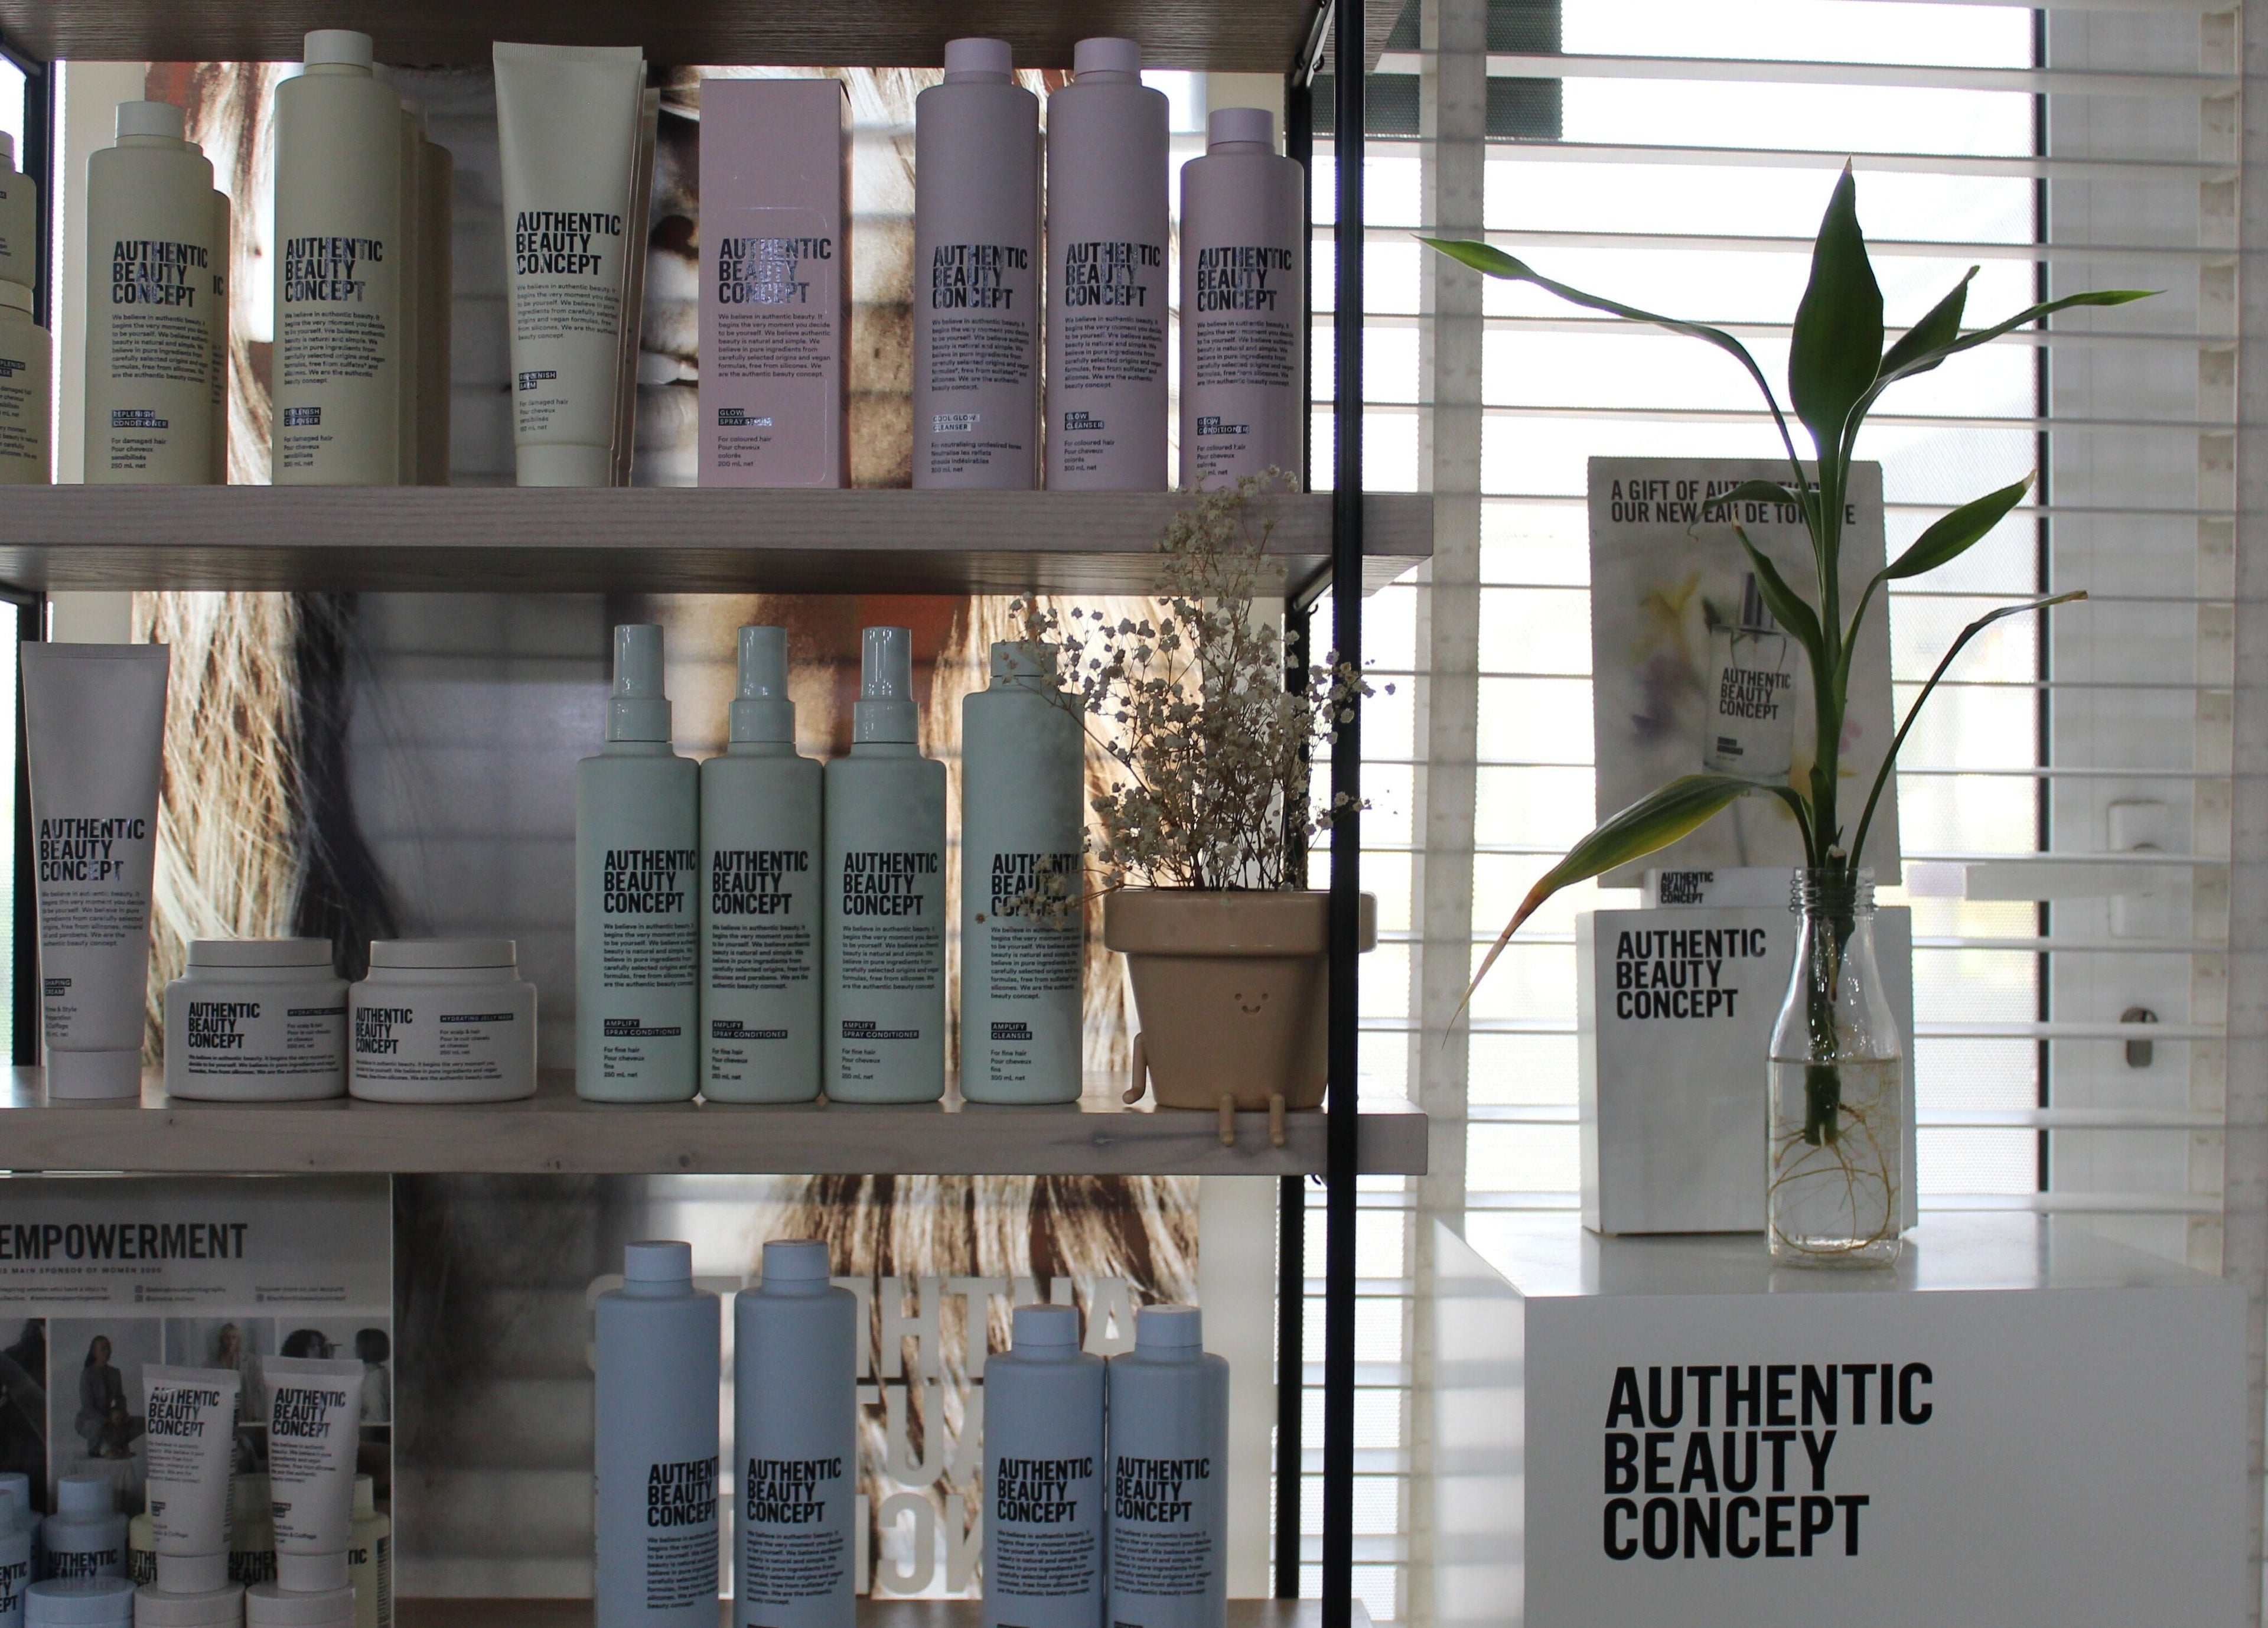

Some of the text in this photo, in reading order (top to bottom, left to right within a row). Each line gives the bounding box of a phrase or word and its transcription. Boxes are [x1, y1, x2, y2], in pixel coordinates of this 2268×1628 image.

[517, 212, 620, 236] AUTHENTIC
[286, 238, 382, 261] AUTHENTIC
[517, 233, 591, 253] BEAUTY
[719, 238, 832, 260] AUTHENTIC
[113, 241, 208, 268] AUTHENTIC
[517, 254, 601, 275] CONCEPT
[933, 245, 1028, 269] AUTHENTIC
[1066, 242, 1161, 267] AUTHENTIC
[1198, 247, 1292, 271] AUTHENTIC
[113, 262, 187, 284] BEAUTY
[285, 259, 355, 281] BEAUTY
[719, 261, 797, 282] BEAUTY
[933, 266, 1003, 288] BEAUTY
[1065, 264, 1136, 286] BEAUTY
[1198, 269, 1267, 291] BEAUTY
[112, 284, 195, 307] CONCEPT
[285, 281, 365, 302] CONCEPT
[718, 282, 810, 304] CONCEPT
[932, 287, 1013, 310] CONCEPT
[1065, 285, 1146, 307] CONCEPT
[1197, 290, 1277, 311] CONCEPT
[0, 360, 24, 370] PLENISH
[1066, 421, 1103, 429] CLEANSER
[1198, 426, 1248, 434] CONDITIONER
[1611, 480, 1622, 501] A
[1629, 480, 1670, 501] GIFT
[1676, 480, 1699, 501] OF
[1611, 502, 1650, 523] OUR
[1657, 503, 1697, 523] NEW
[1704, 503, 1738, 523] EAU
[1745, 503, 1769, 524] DE
[1722, 668, 1791, 689] AUTHENTIC
[1721, 683, 1772, 704] BEAUTY
[1720, 700, 1778, 721] CONCEPT
[41, 818, 145, 839] AUTHENTIC
[41, 839, 112, 861] BEAUTY
[604, 849, 695, 871] AUTHENTIC
[713, 850, 808, 871] AUTHENTIC
[41, 860, 124, 881] CONCEPT
[844, 852, 937, 873] AUTHENTIC
[604, 871, 676, 892] BEAUTY
[712, 872, 782, 893] BEAUTY
[843, 874, 915, 894] BEAUTY
[1661, 872, 1713, 883] AUTHENTIC
[1661, 883, 1697, 893] BEAUTY
[604, 892, 685, 913] CONCEPT
[712, 893, 792, 914] CONCEPT
[843, 895, 924, 916] CONCEPT
[1661, 893, 1703, 904] CONCEPT
[1617, 929, 1766, 960] AUTHENTIC
[1617, 959, 1722, 989] BEAUTY
[189, 1002, 260, 1018] AUTHENTIC
[1617, 989, 1738, 1019] CONCEPT
[188, 1017, 236, 1033] BEAUTY
[356, 1007, 413, 1024] AUTHENTIC
[188, 1033, 245, 1049] CONCEPT
[356, 1023, 392, 1038] BEAUTY
[356, 1037, 399, 1054] CONCEPT
[0, 1223, 247, 1259] EMPOWERMENT
[151, 1387, 220, 1406] AUTHENTIC
[275, 1389, 346, 1407] AUTHENTIC
[1604, 1362, 1933, 1429] AUTHENTIC
[149, 1404, 200, 1420] BEAUTY
[274, 1404, 327, 1421] BEAUTY
[148, 1418, 205, 1437] CONCEPT
[272, 1420, 330, 1438] CONCEPT
[649, 1456, 719, 1484] AUTHENT
[748, 1457, 841, 1481] AUTHENTIC
[998, 1457, 1092, 1480] AUTHENTIC
[1116, 1456, 1210, 1480] AUTHENTIC
[1604, 1430, 1837, 1495] BEAUTY
[648, 1480, 712, 1506] BEAUTY
[748, 1479, 816, 1502] BEAUTY
[998, 1479, 1067, 1502] BEAUTY
[1116, 1477, 1182, 1501] BEAUTY
[648, 1499, 716, 1527] CONCEPT
[748, 1500, 825, 1523] CONCEPT
[998, 1499, 1077, 1523] CONCEPT
[1116, 1497, 1192, 1522] CONCEPT
[1603, 1495, 1869, 1561] CONCEPT
[48, 1548, 118, 1567] AUTHENTIC
